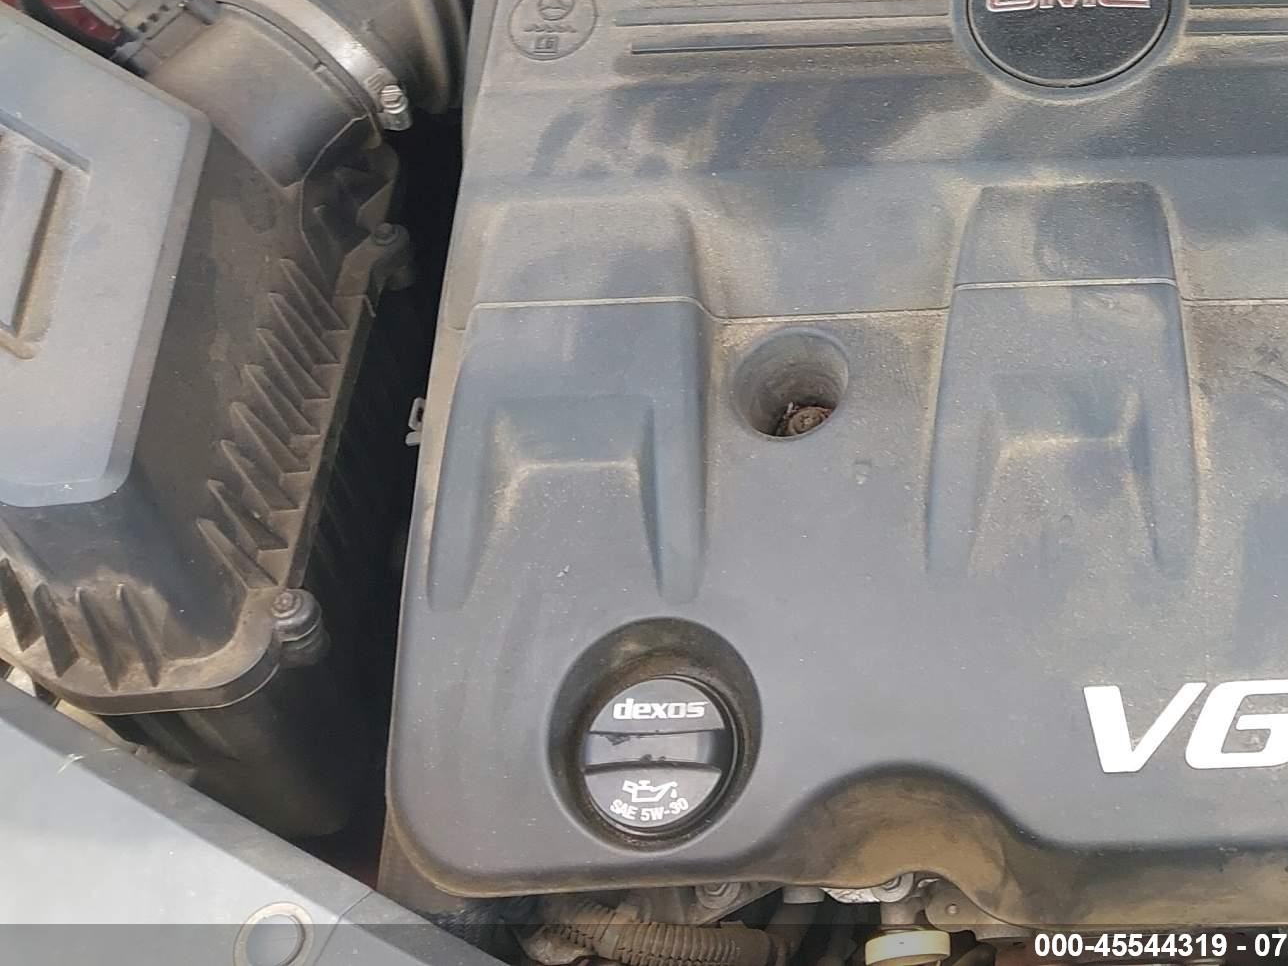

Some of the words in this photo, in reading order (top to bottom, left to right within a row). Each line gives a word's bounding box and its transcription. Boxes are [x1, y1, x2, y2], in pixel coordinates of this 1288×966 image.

[613, 698, 709, 720] dexos
[610, 799, 638, 820] SAE
[640, 798, 689, 821] 5W-30
